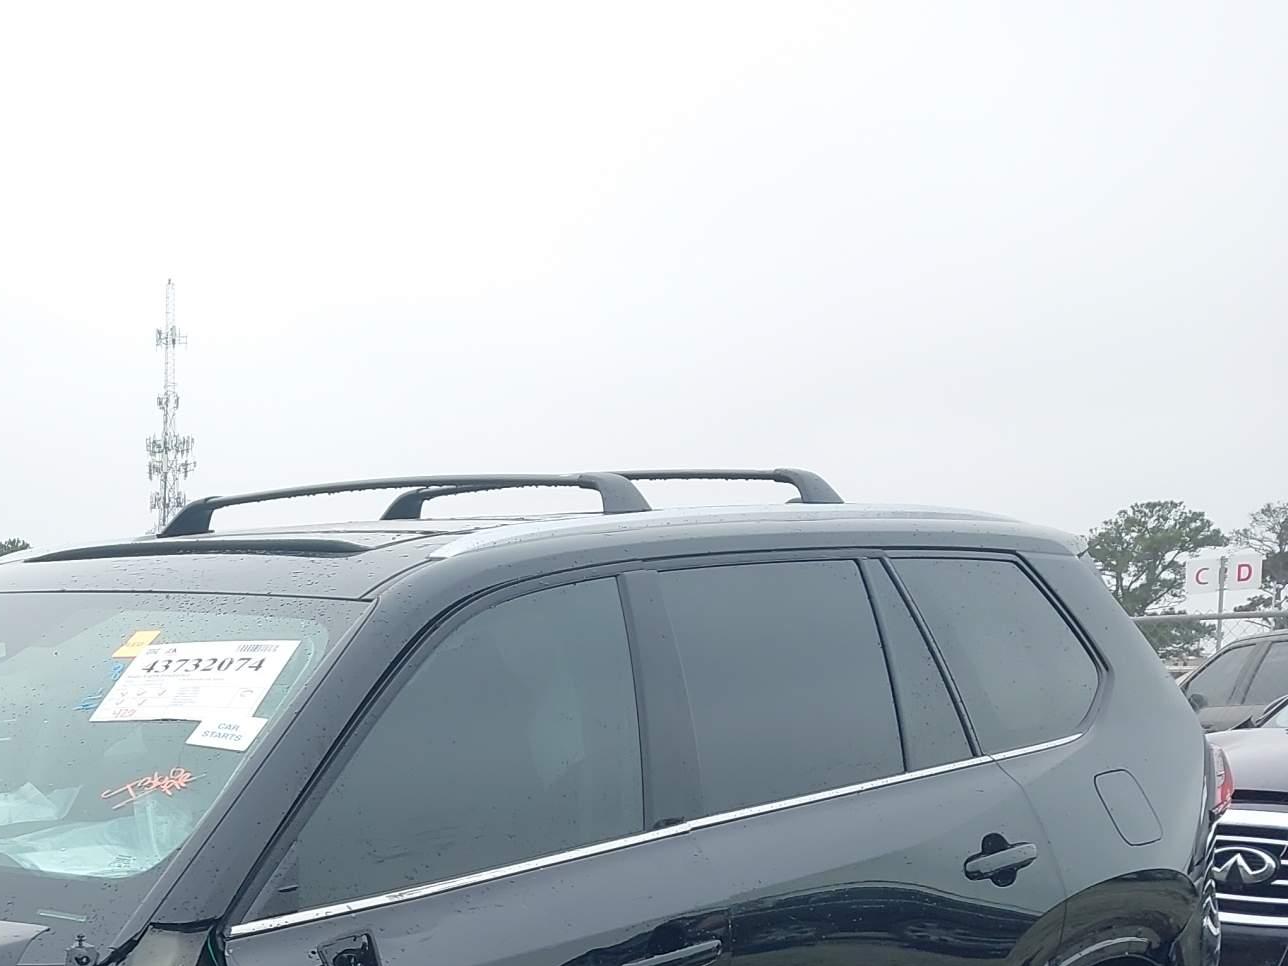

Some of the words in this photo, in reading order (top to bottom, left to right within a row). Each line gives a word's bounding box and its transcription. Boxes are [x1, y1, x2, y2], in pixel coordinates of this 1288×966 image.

[1195, 567, 1210, 585] C
[1237, 564, 1253, 582] D
[141, 657, 266, 673] 43732074
[218, 723, 240, 732] CAR
[201, 730, 242, 742] STARTS
